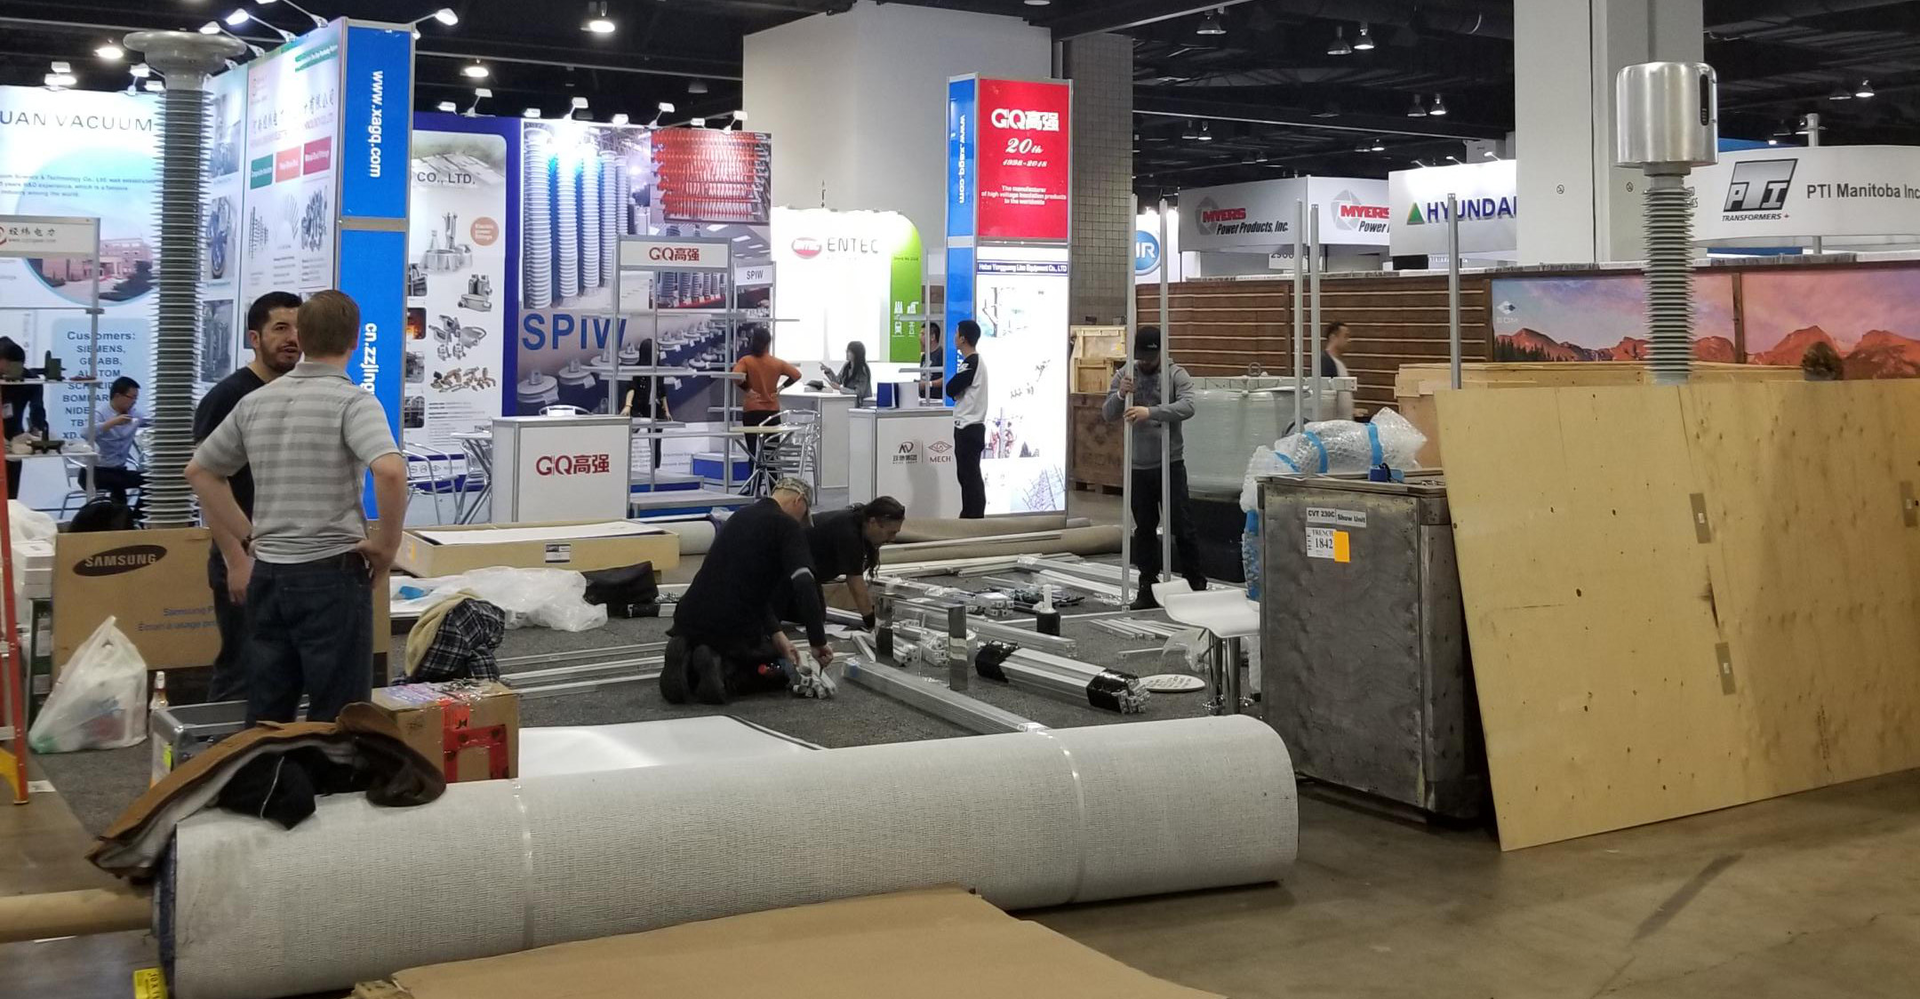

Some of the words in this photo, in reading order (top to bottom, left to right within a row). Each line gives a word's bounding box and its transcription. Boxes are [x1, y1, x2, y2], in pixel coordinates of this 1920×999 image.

[55, 114, 152, 131] VACUUM
[368, 70, 384, 178] www.xagq.com
[1005, 137, 1043, 154] 20th
[417, 171, 444, 185] CO.,
[448, 173, 476, 185] LTD.
[1807, 184, 1831, 199] PTI
[1837, 183, 1900, 199] Manitoba
[1722, 212, 1782, 222] TRANSFORMERS
[1217, 223, 1240, 236] Power
[1239, 221, 1273, 233] Products,
[1274, 220, 1289, 232] Inc.
[1358, 220, 1386, 233] Power
[827, 237, 879, 254] ENTEC
[649, 247, 700, 261] GQ高强
[746, 270, 764, 280] SPIW
[67, 331, 136, 341] Cusomers:
[522, 313, 628, 351] SPIW
[361, 322, 380, 395] cn.zzjing
[535, 454, 610, 476] GQ高强
[929, 455, 952, 463] MECH
[1315, 538, 1333, 550] 1842
[84, 553, 157, 568] SAMSUNG
